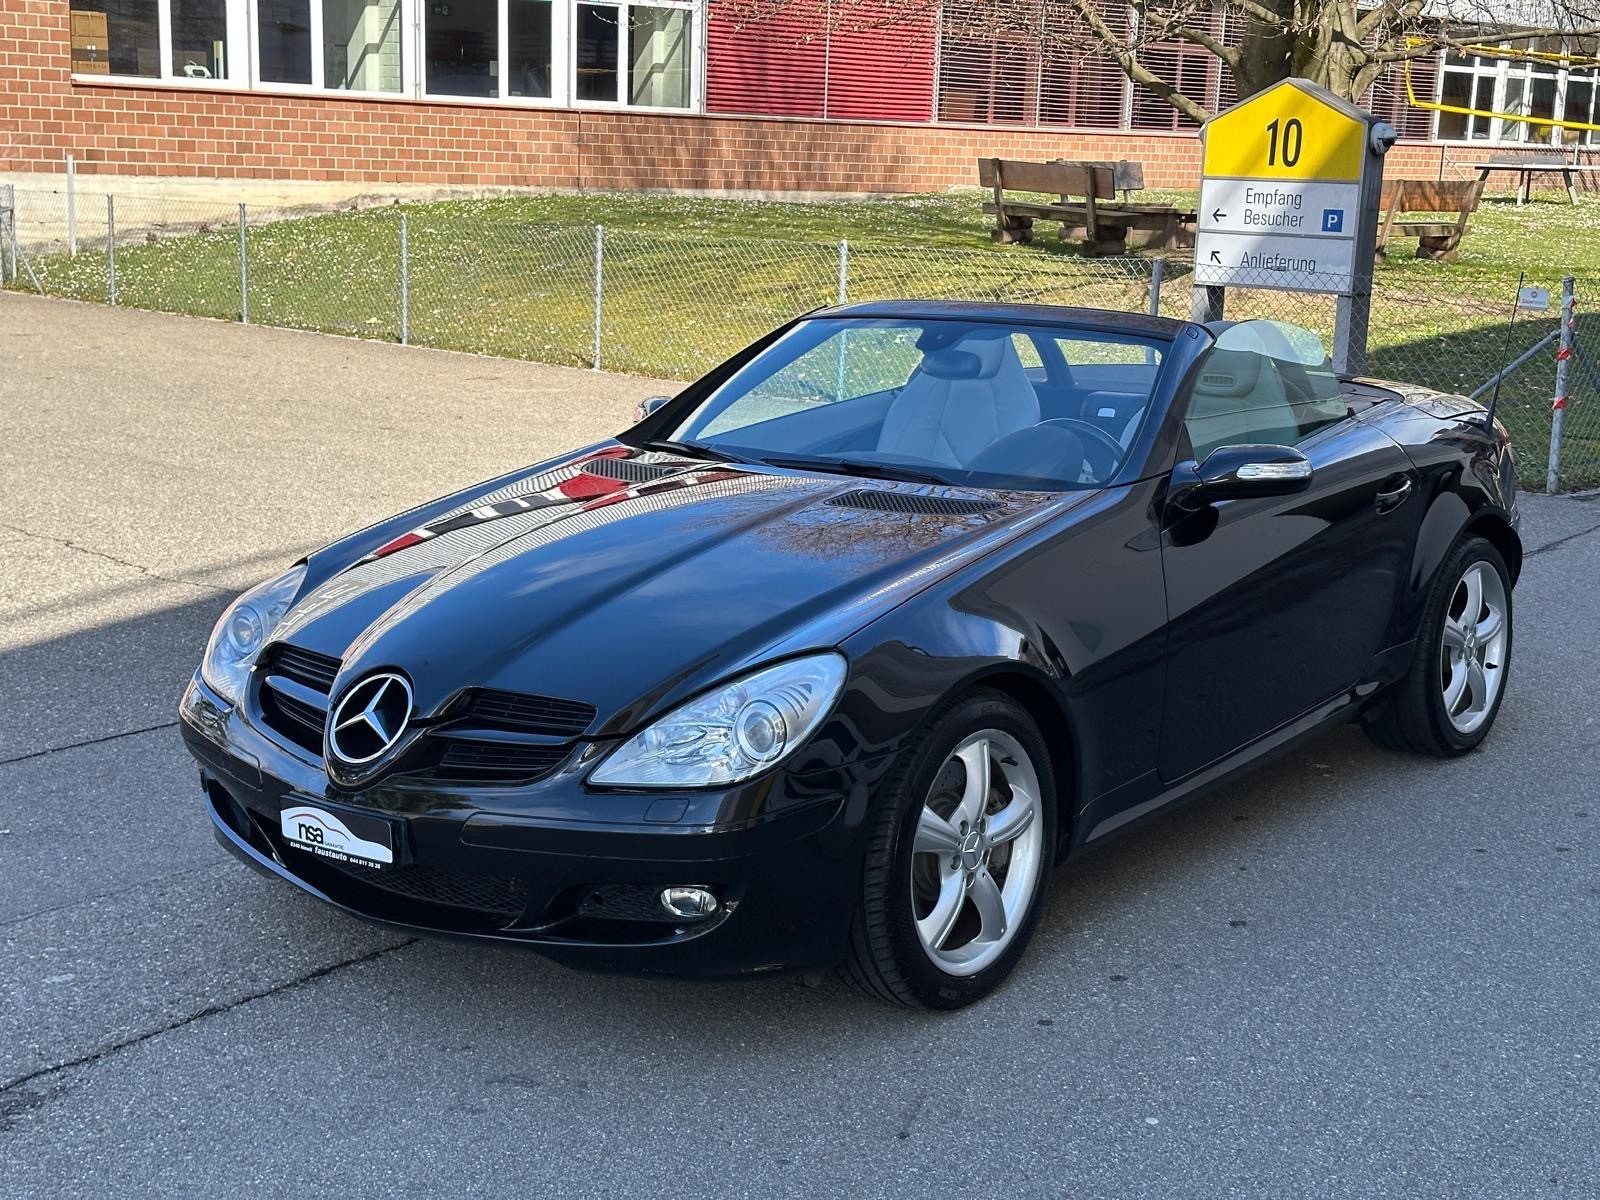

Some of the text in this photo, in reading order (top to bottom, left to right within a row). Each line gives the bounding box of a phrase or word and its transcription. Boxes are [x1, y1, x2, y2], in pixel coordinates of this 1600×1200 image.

[1266, 118, 1303, 168] 10
[1245, 187, 1302, 210] Empfang
[1243, 208, 1304, 228] Besucher
[1327, 214, 1338, 228] P
[1240, 251, 1316, 275] Anlieferung
[298, 822, 324, 845] nsa
[314, 845, 348, 862] faustauto
